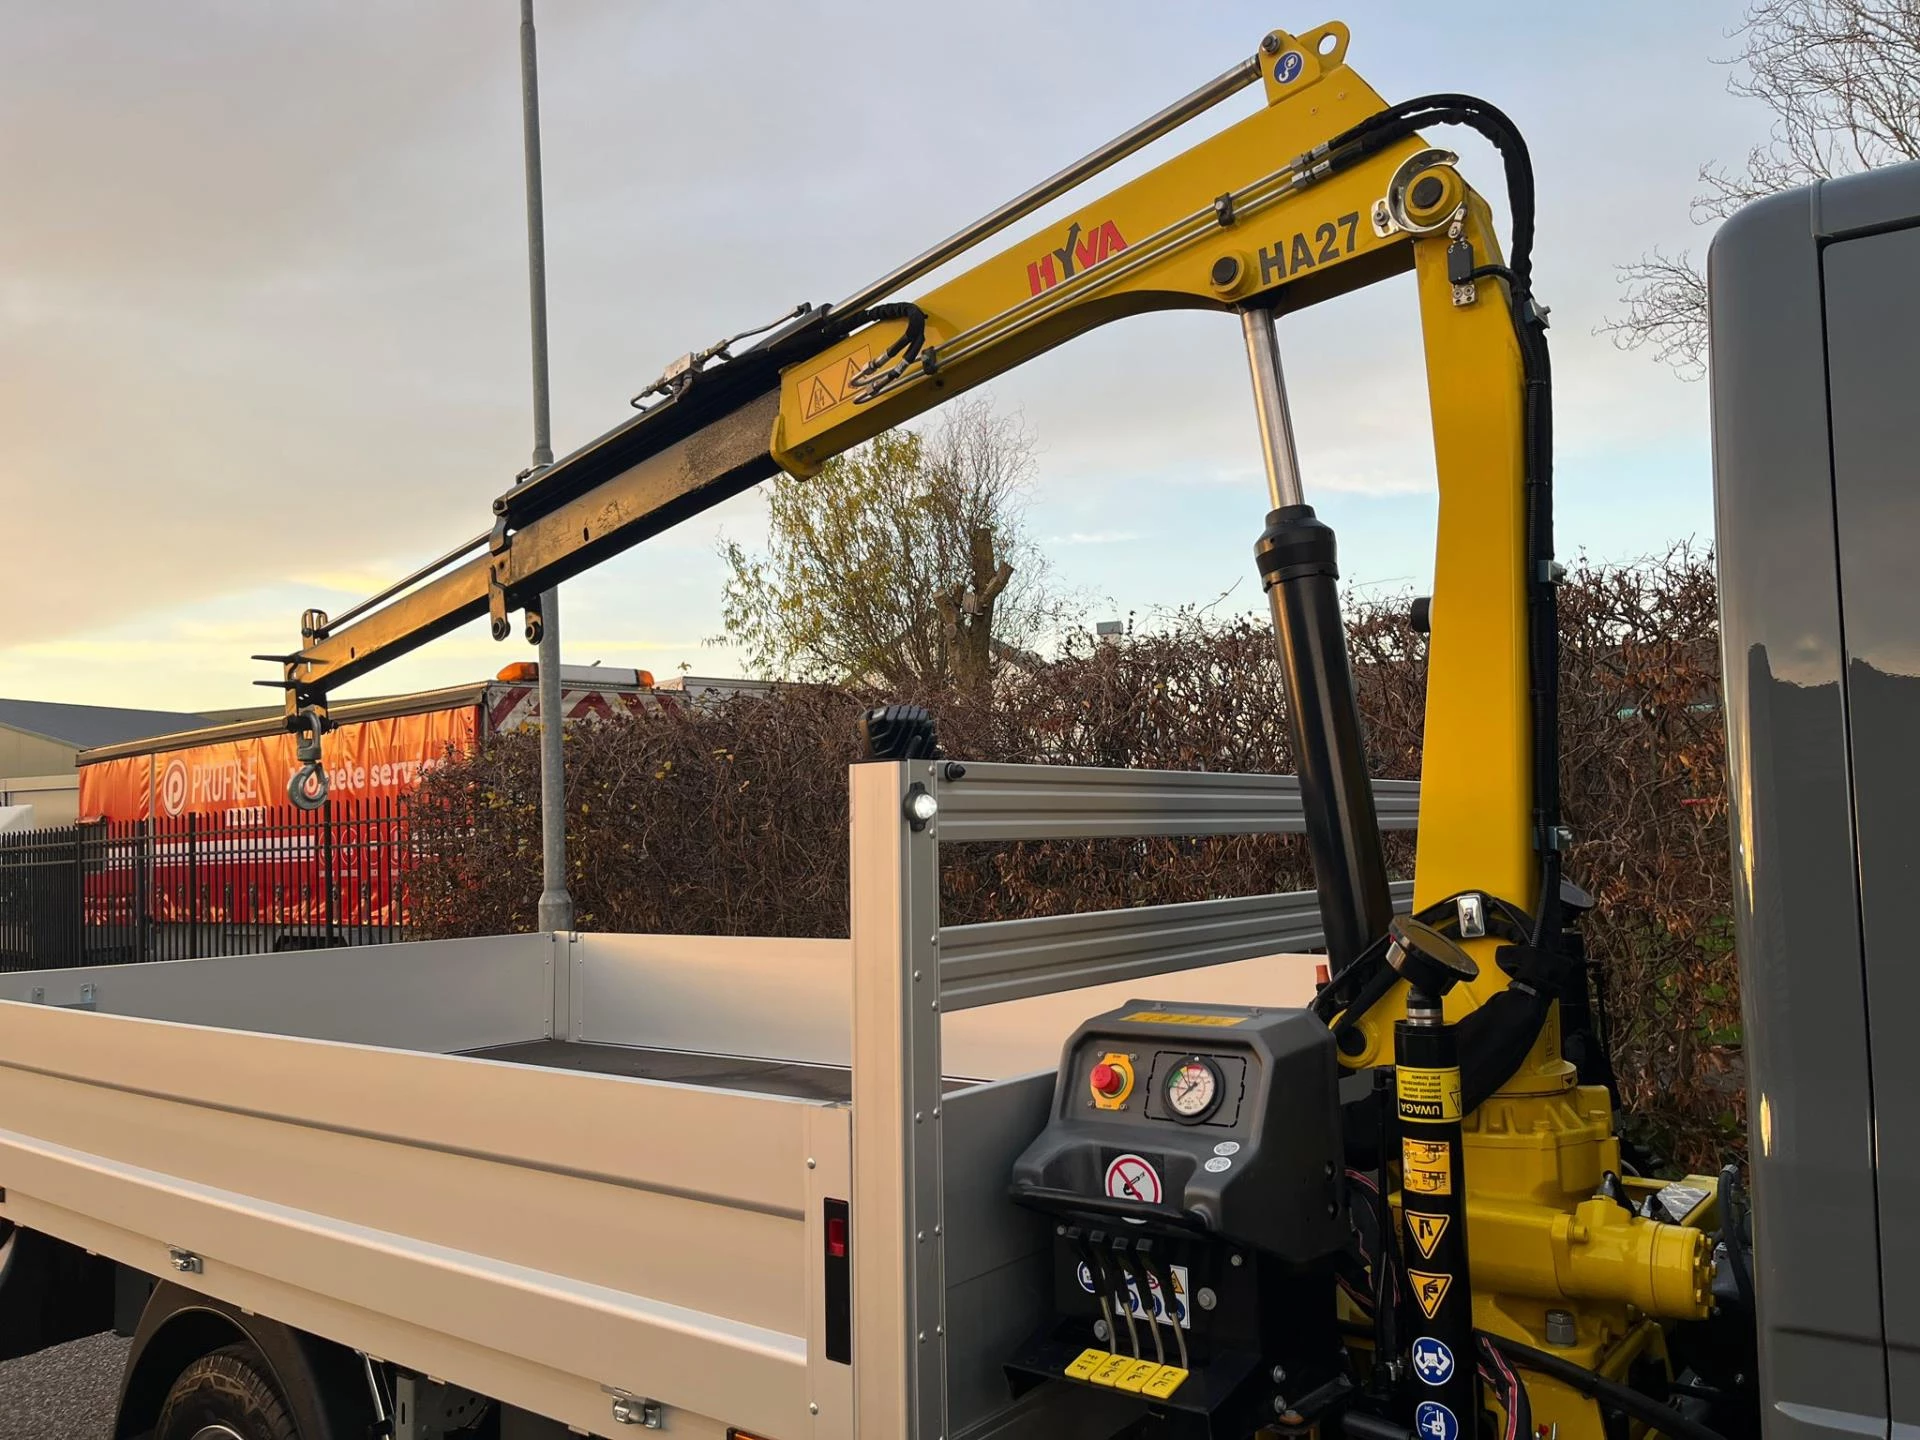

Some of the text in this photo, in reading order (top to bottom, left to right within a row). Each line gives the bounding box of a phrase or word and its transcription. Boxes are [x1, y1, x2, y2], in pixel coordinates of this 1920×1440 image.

[1026, 220, 1129, 296] HYVA
[1258, 210, 1360, 286] HA27
[1400, 1102, 1440, 1115] UWAGA
